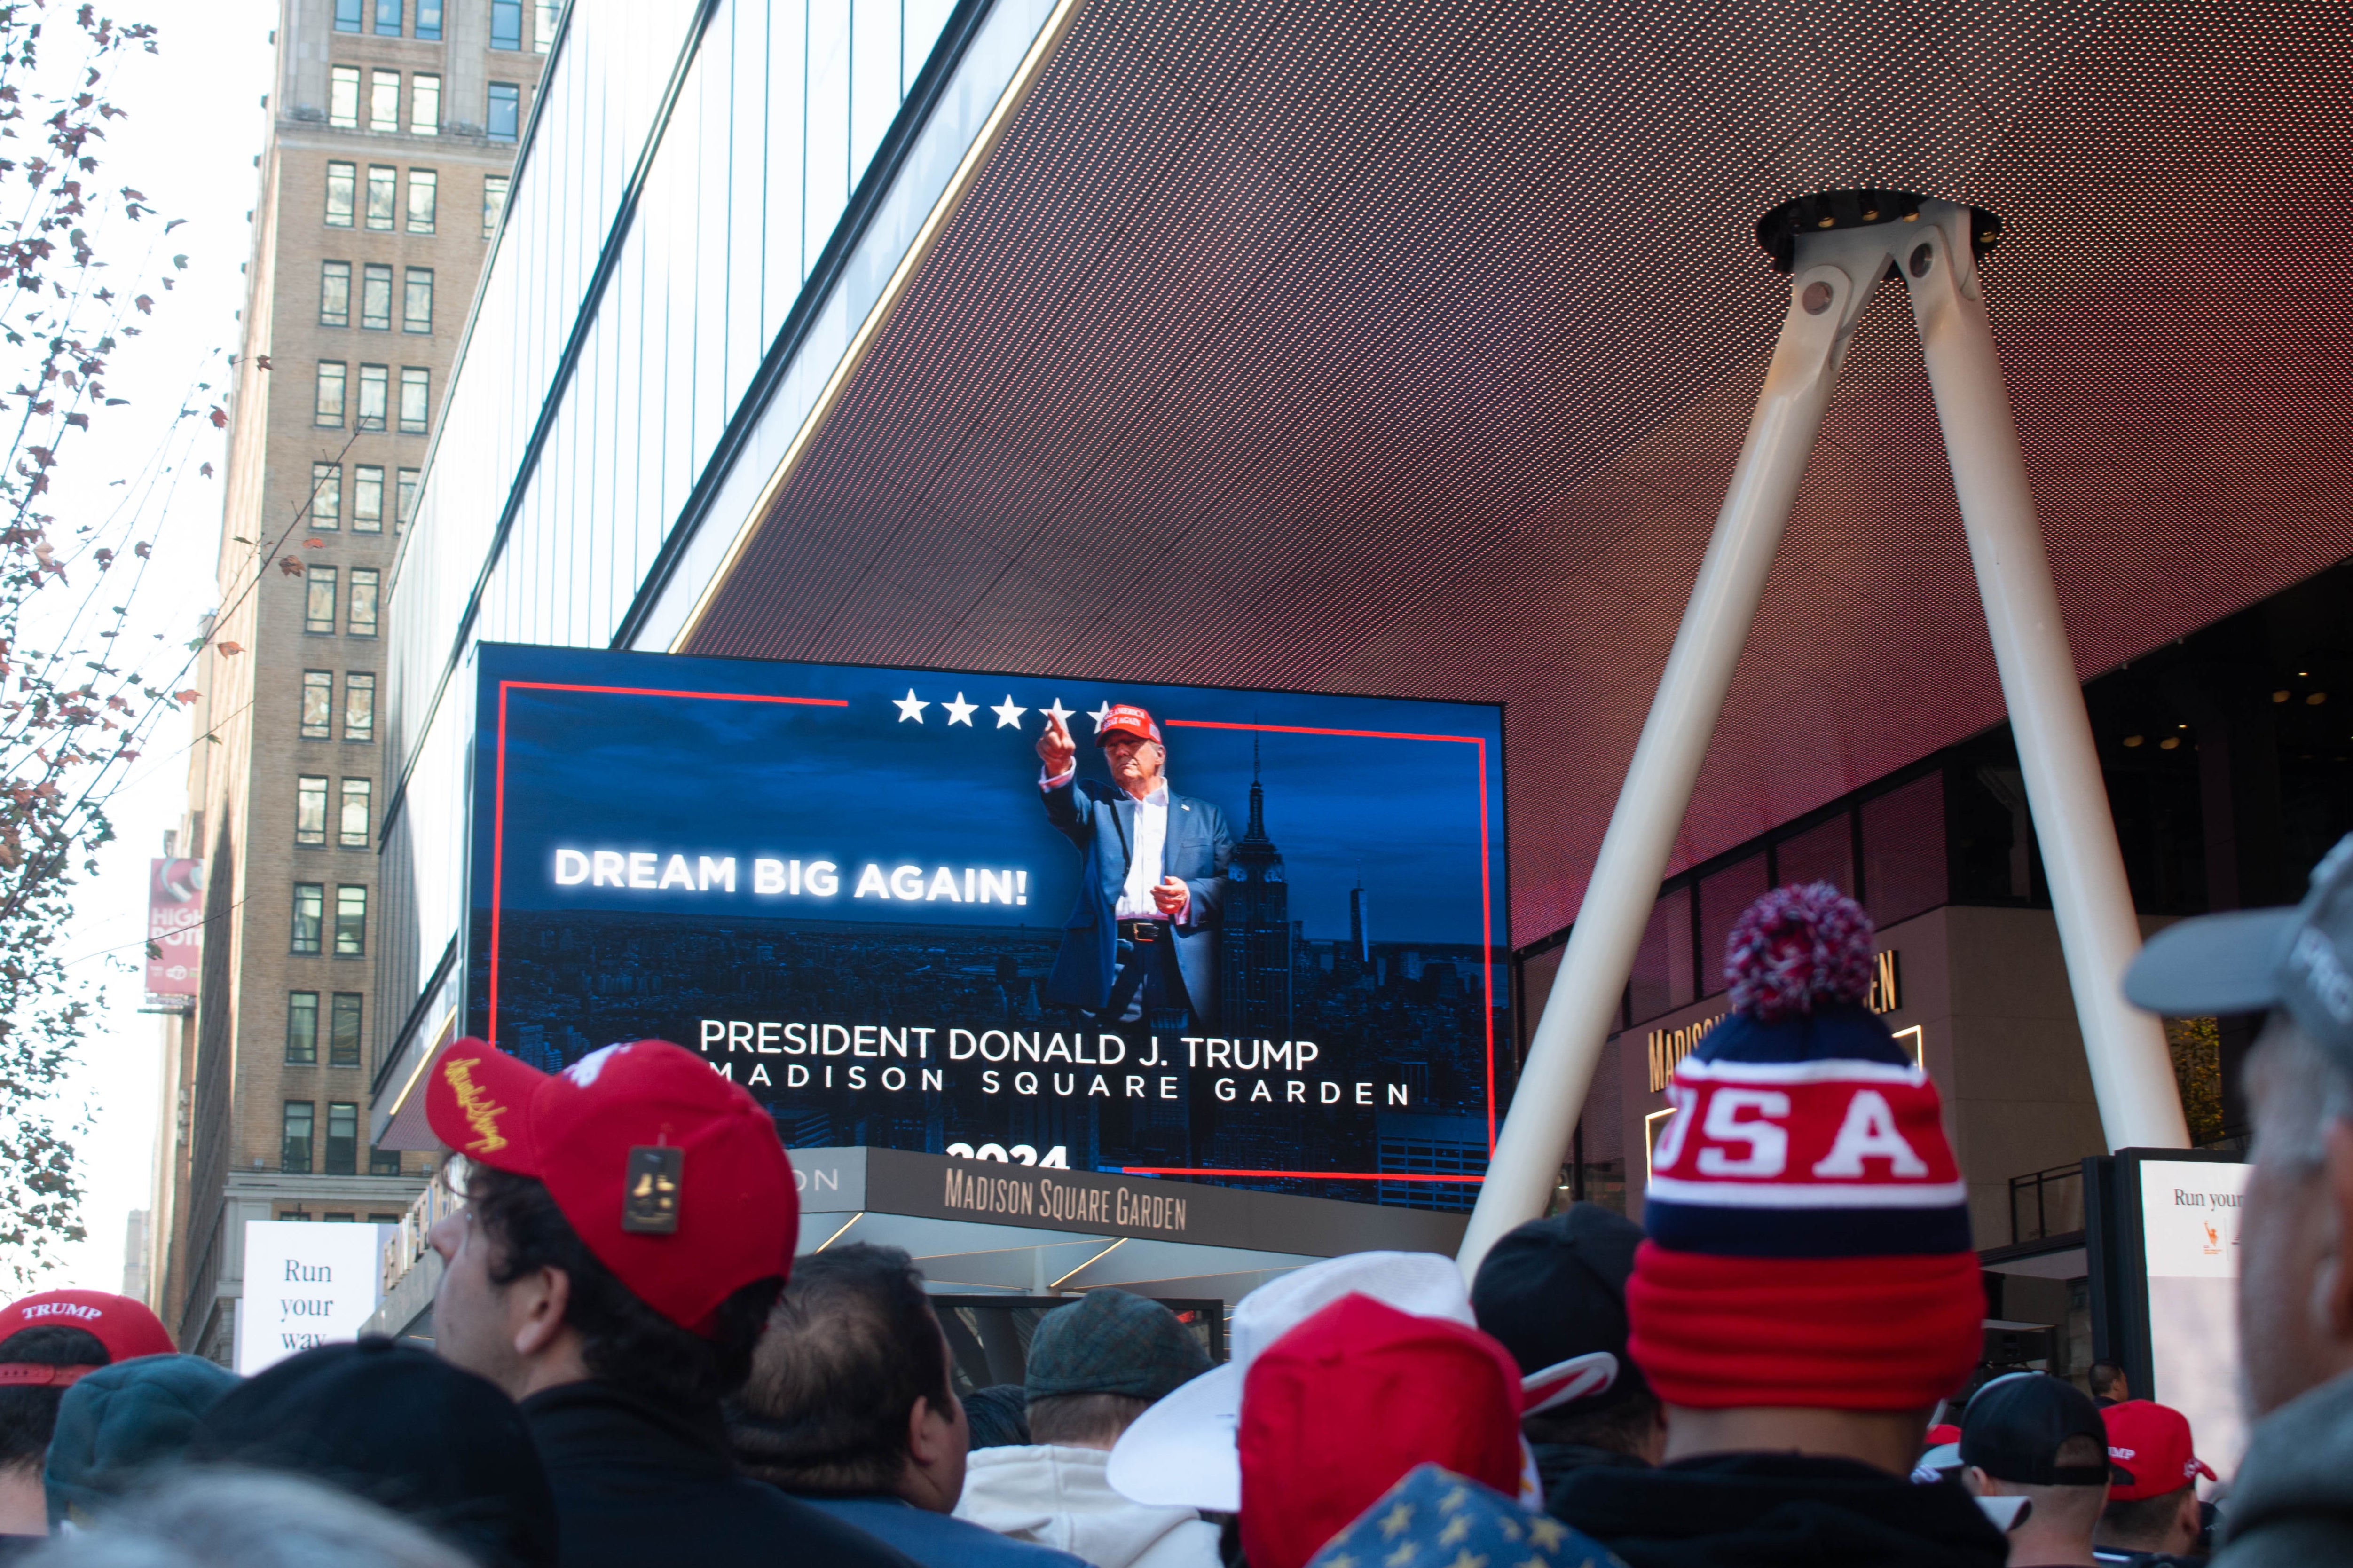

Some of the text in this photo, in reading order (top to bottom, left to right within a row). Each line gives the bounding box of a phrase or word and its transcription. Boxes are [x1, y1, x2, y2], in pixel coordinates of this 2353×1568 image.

[555, 849, 1028, 906] DREAM BIG AGAIN!
[700, 1019, 1319, 1071] PRESIDENT DONALD J. TRUMP
[982, 1070, 1178, 1099] SQUARE
[1214, 1078, 1408, 1106] GARDEN
[944, 1168, 1187, 1231] MADISON SQUARE GARDEN
[2174, 1188, 2244, 1212] Run your
[284, 1259, 332, 1282] Run
[22, 1302, 103, 1321] TRUMP
[280, 1298, 334, 1323] your
